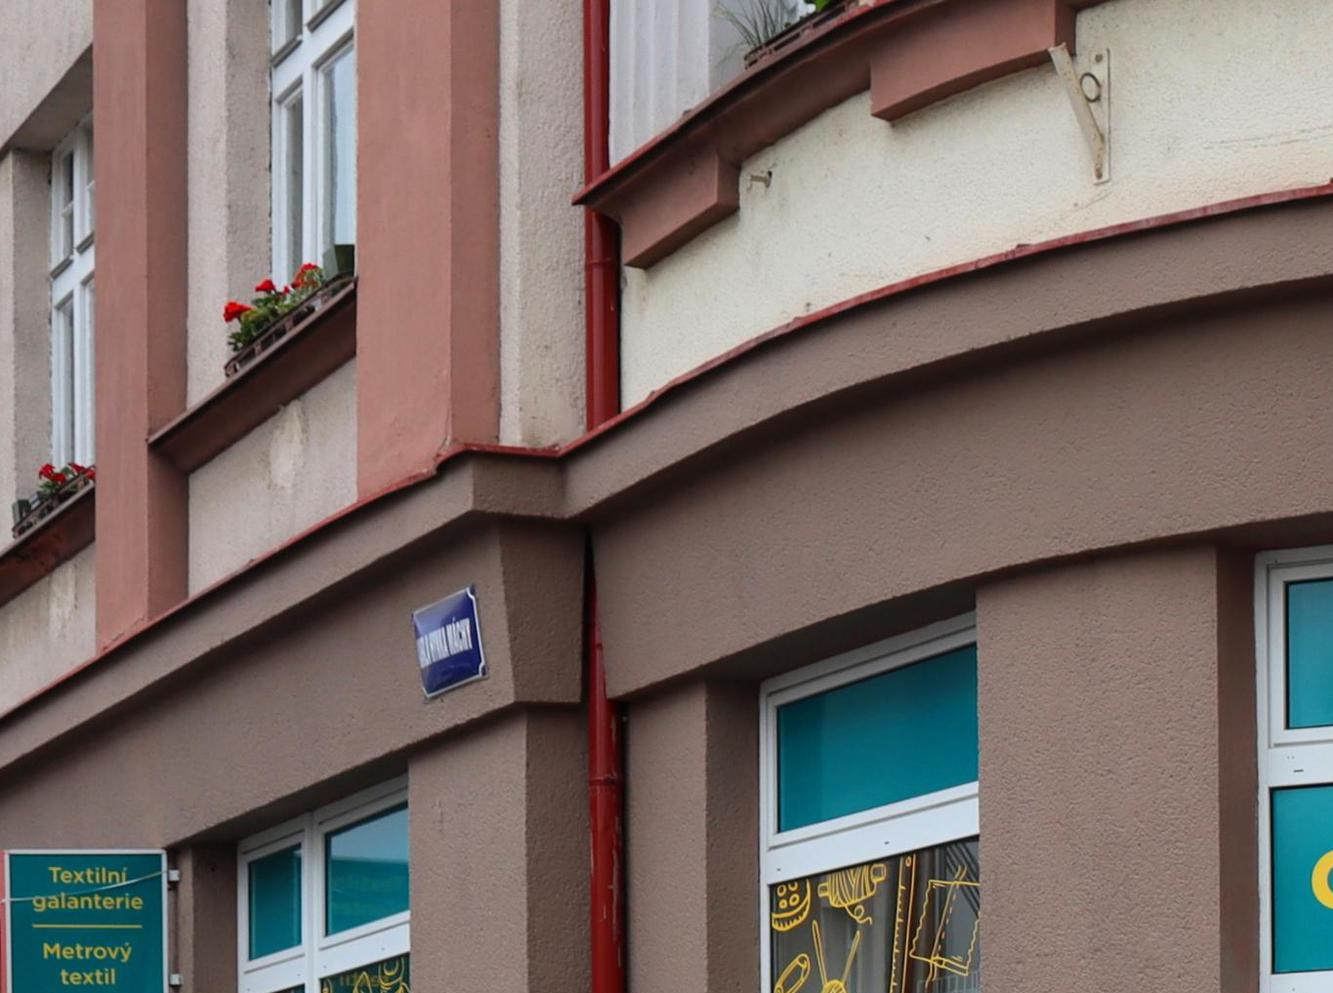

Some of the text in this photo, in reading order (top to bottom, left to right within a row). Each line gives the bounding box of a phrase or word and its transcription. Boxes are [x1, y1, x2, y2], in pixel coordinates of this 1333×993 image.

[48, 866, 127, 884] Textilní
[32, 892, 144, 912] galanterie
[43, 942, 132, 962] Metrový
[60, 968, 116, 985] textil
